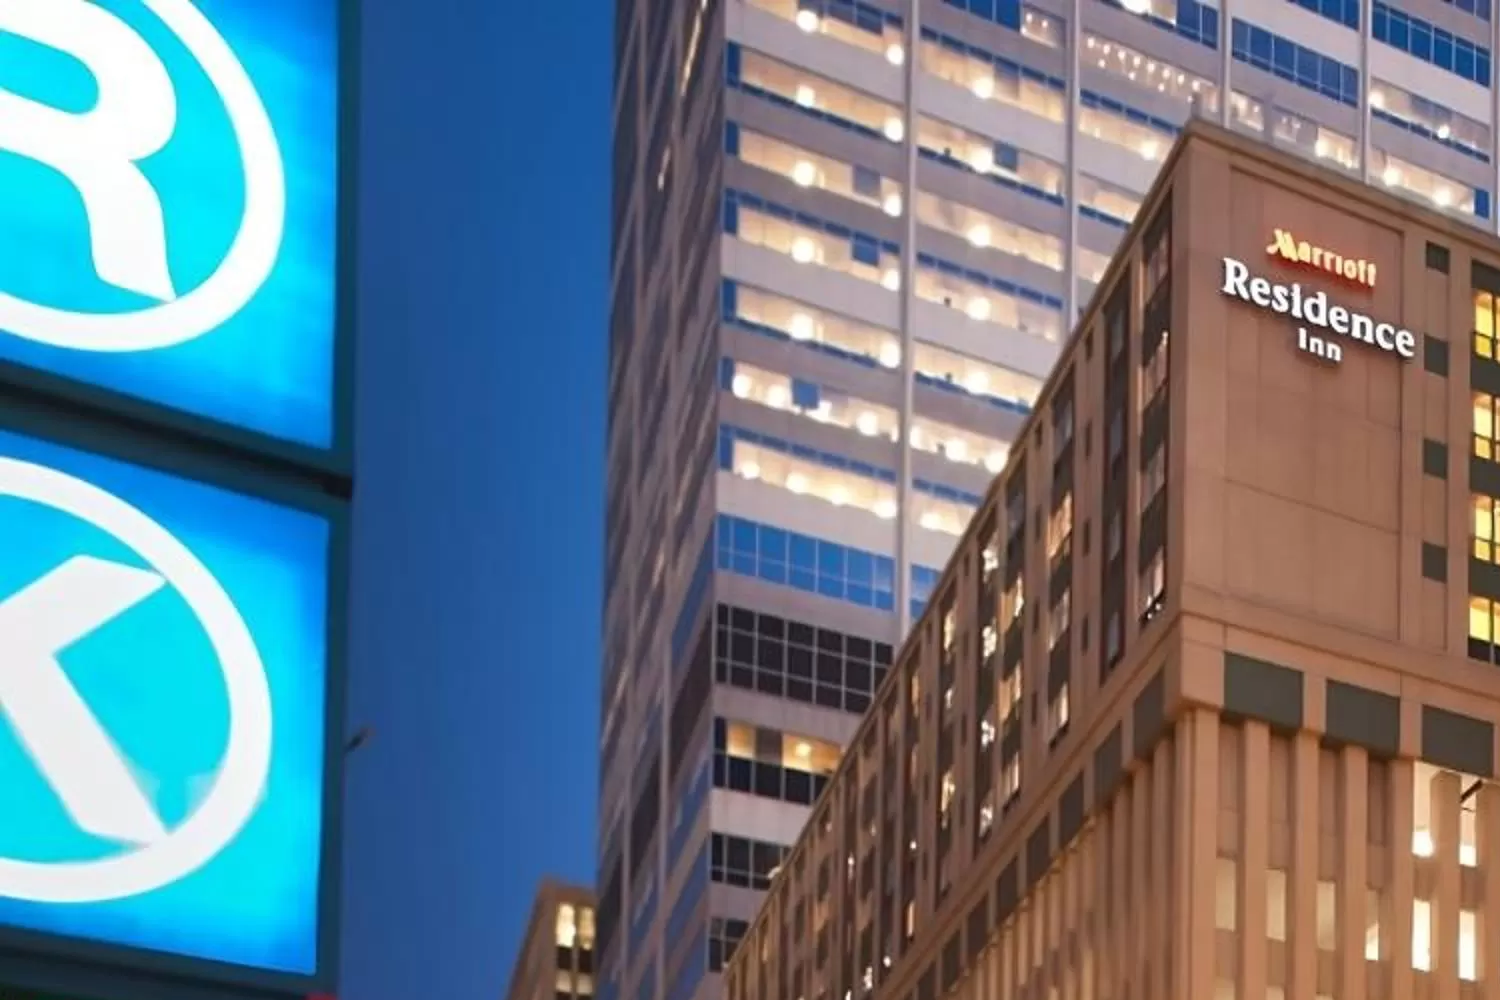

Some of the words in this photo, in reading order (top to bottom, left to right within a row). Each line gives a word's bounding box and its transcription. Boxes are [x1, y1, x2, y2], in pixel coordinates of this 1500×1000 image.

[1266, 228, 1377, 287] Marriott
[1221, 256, 1415, 358] Residence
[1298, 327, 1343, 362] Inn
